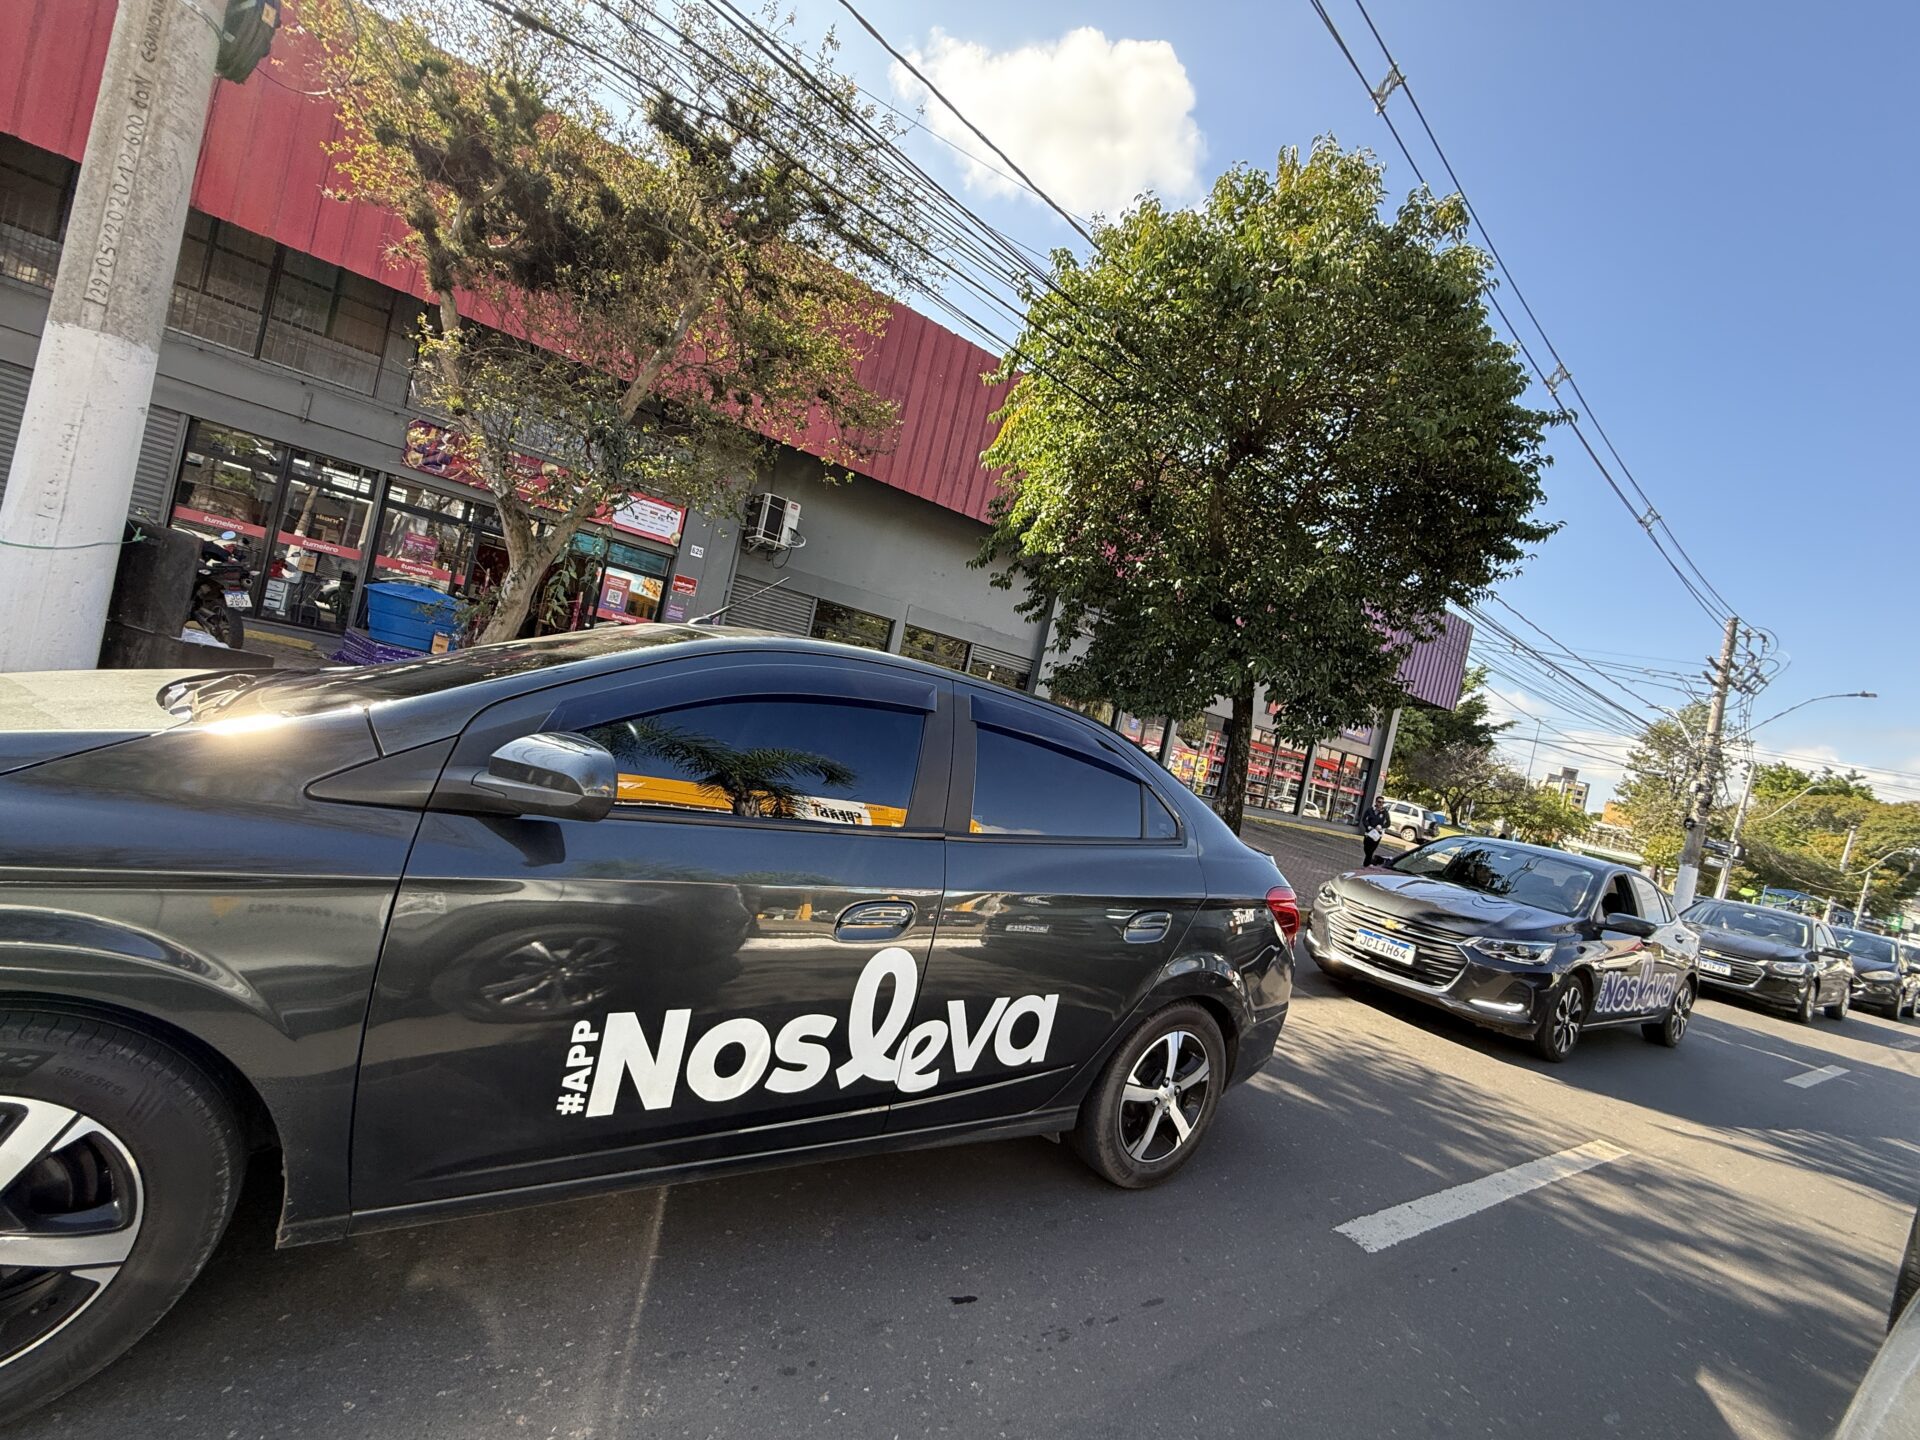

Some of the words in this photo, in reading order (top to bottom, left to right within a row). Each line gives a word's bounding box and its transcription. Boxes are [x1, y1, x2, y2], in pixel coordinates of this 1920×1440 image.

[203, 515, 244, 531] tumelero
[302, 540, 339, 554] tumelero
[401, 563, 434, 576] tumelero
[1359, 935, 1407, 960] JCI1H64
[555, 1019, 600, 1116] #APP
